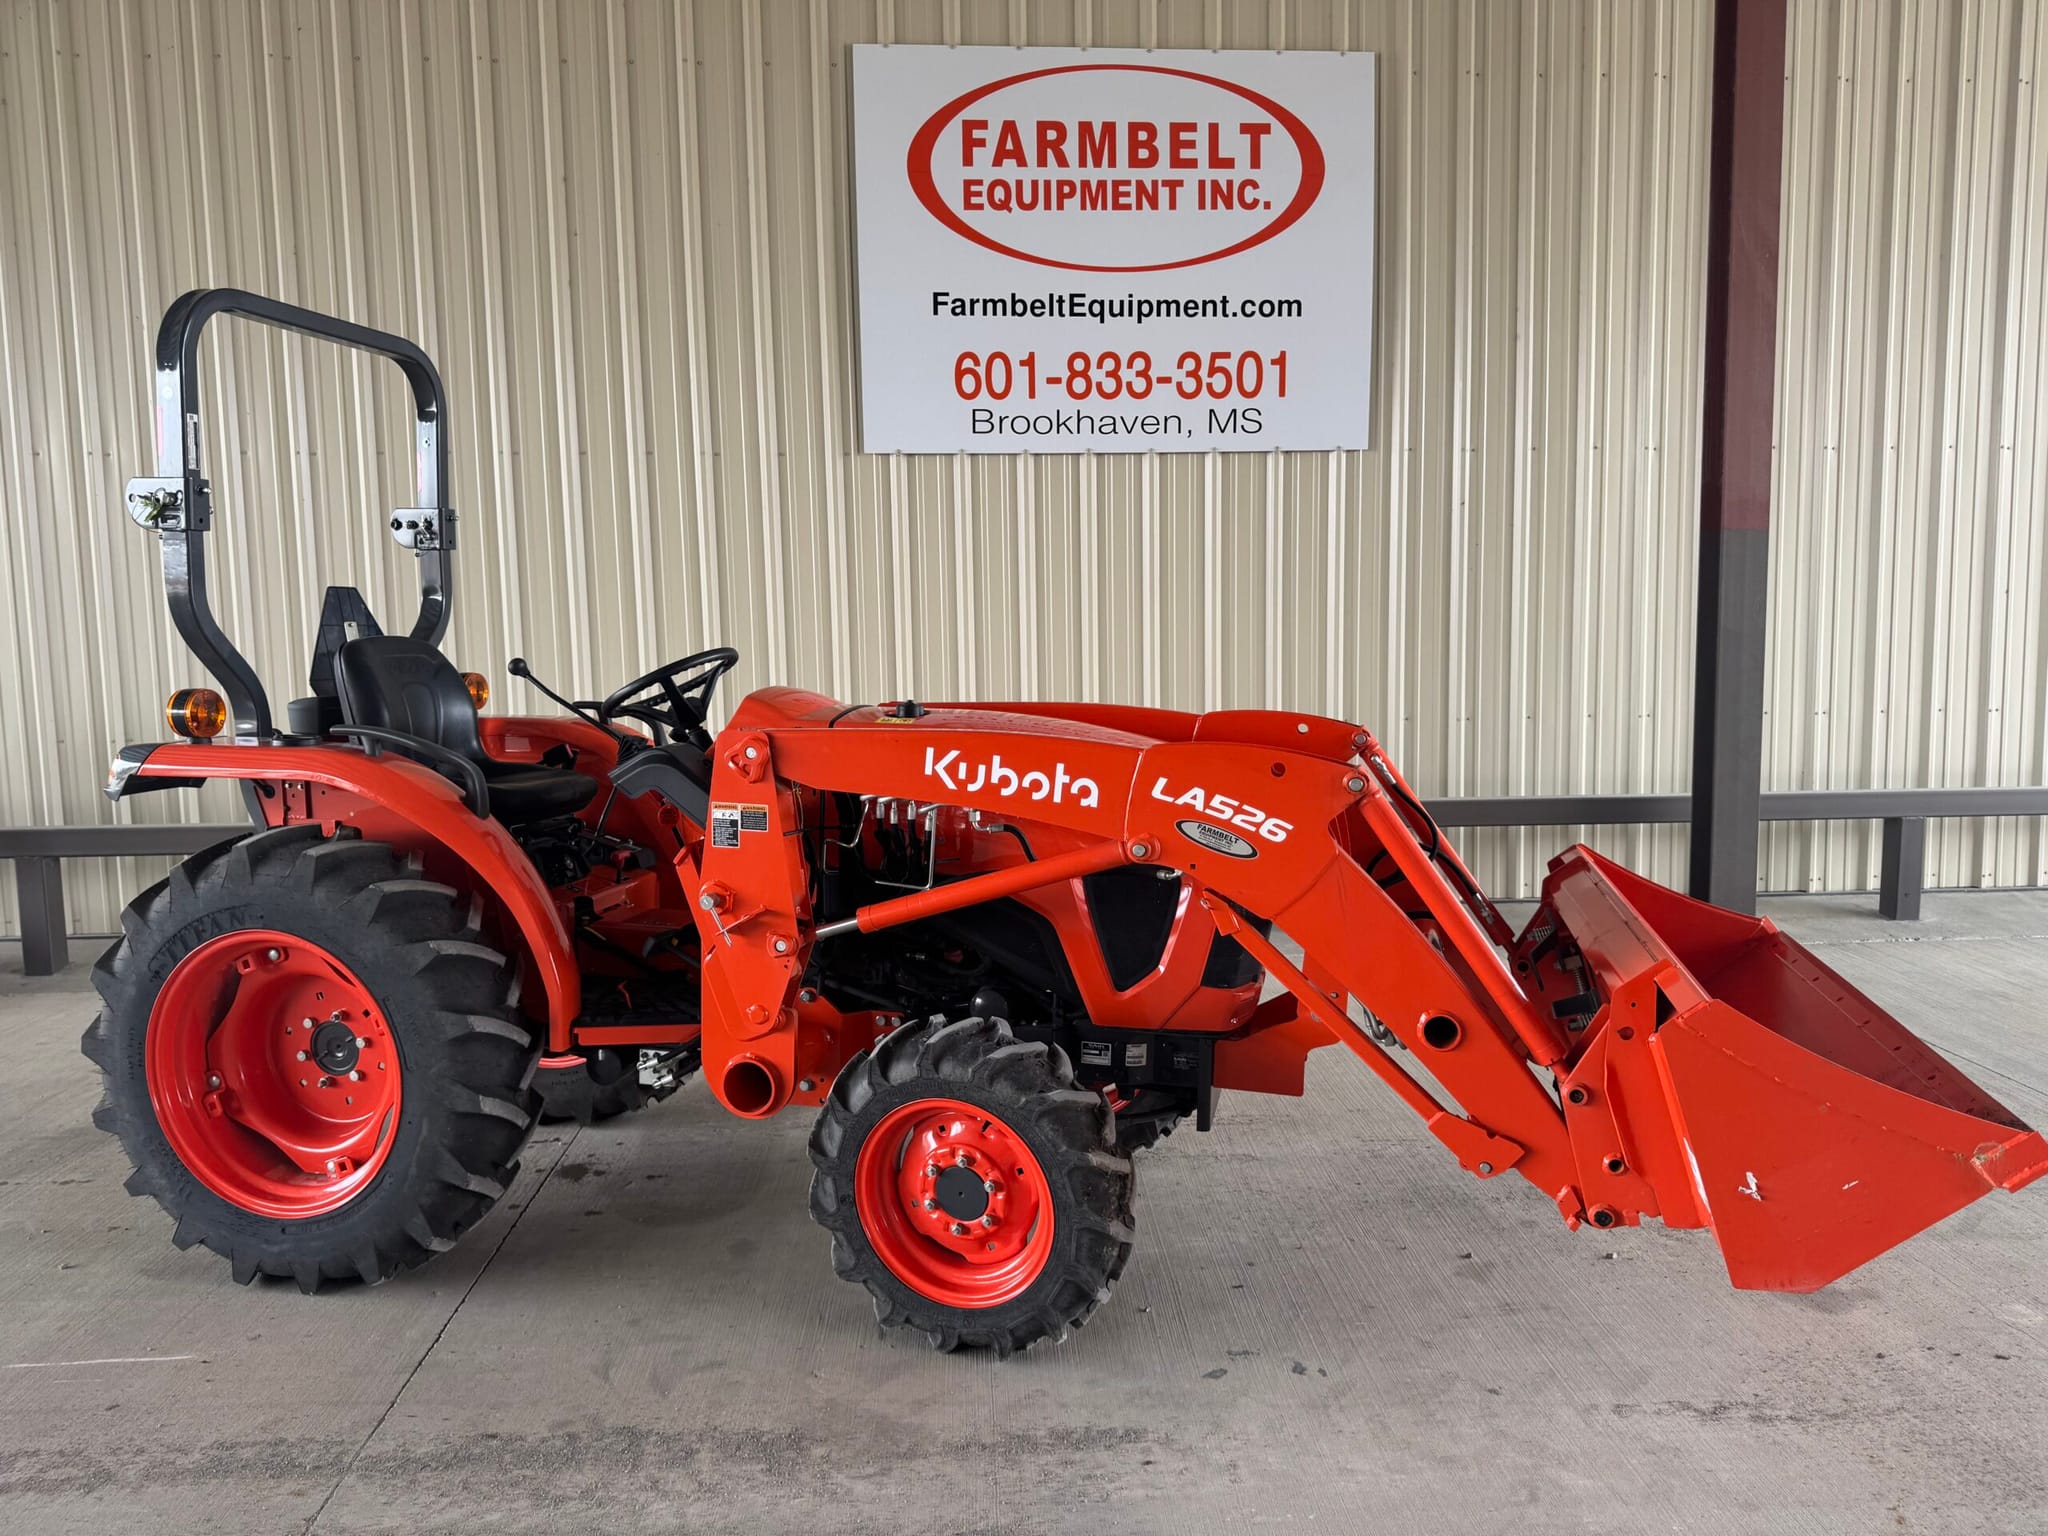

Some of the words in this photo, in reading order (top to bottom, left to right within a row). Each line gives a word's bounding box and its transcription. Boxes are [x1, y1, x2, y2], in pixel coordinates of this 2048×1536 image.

[961, 119, 1272, 170] FARMBELT
[962, 178, 1184, 214] EQUIPMENT
[1197, 179, 1272, 211] INC.
[931, 292, 1303, 324] FarmbeltEquipment.com
[954, 350, 1287, 401] 601-833-3501
[971, 408, 1193, 438] Brookhaven,
[1207, 408, 1263, 434] MS
[924, 746, 1099, 809] Kubota
[1151, 776, 1294, 843] LA526
[1196, 823, 1239, 844] FARMBELT
